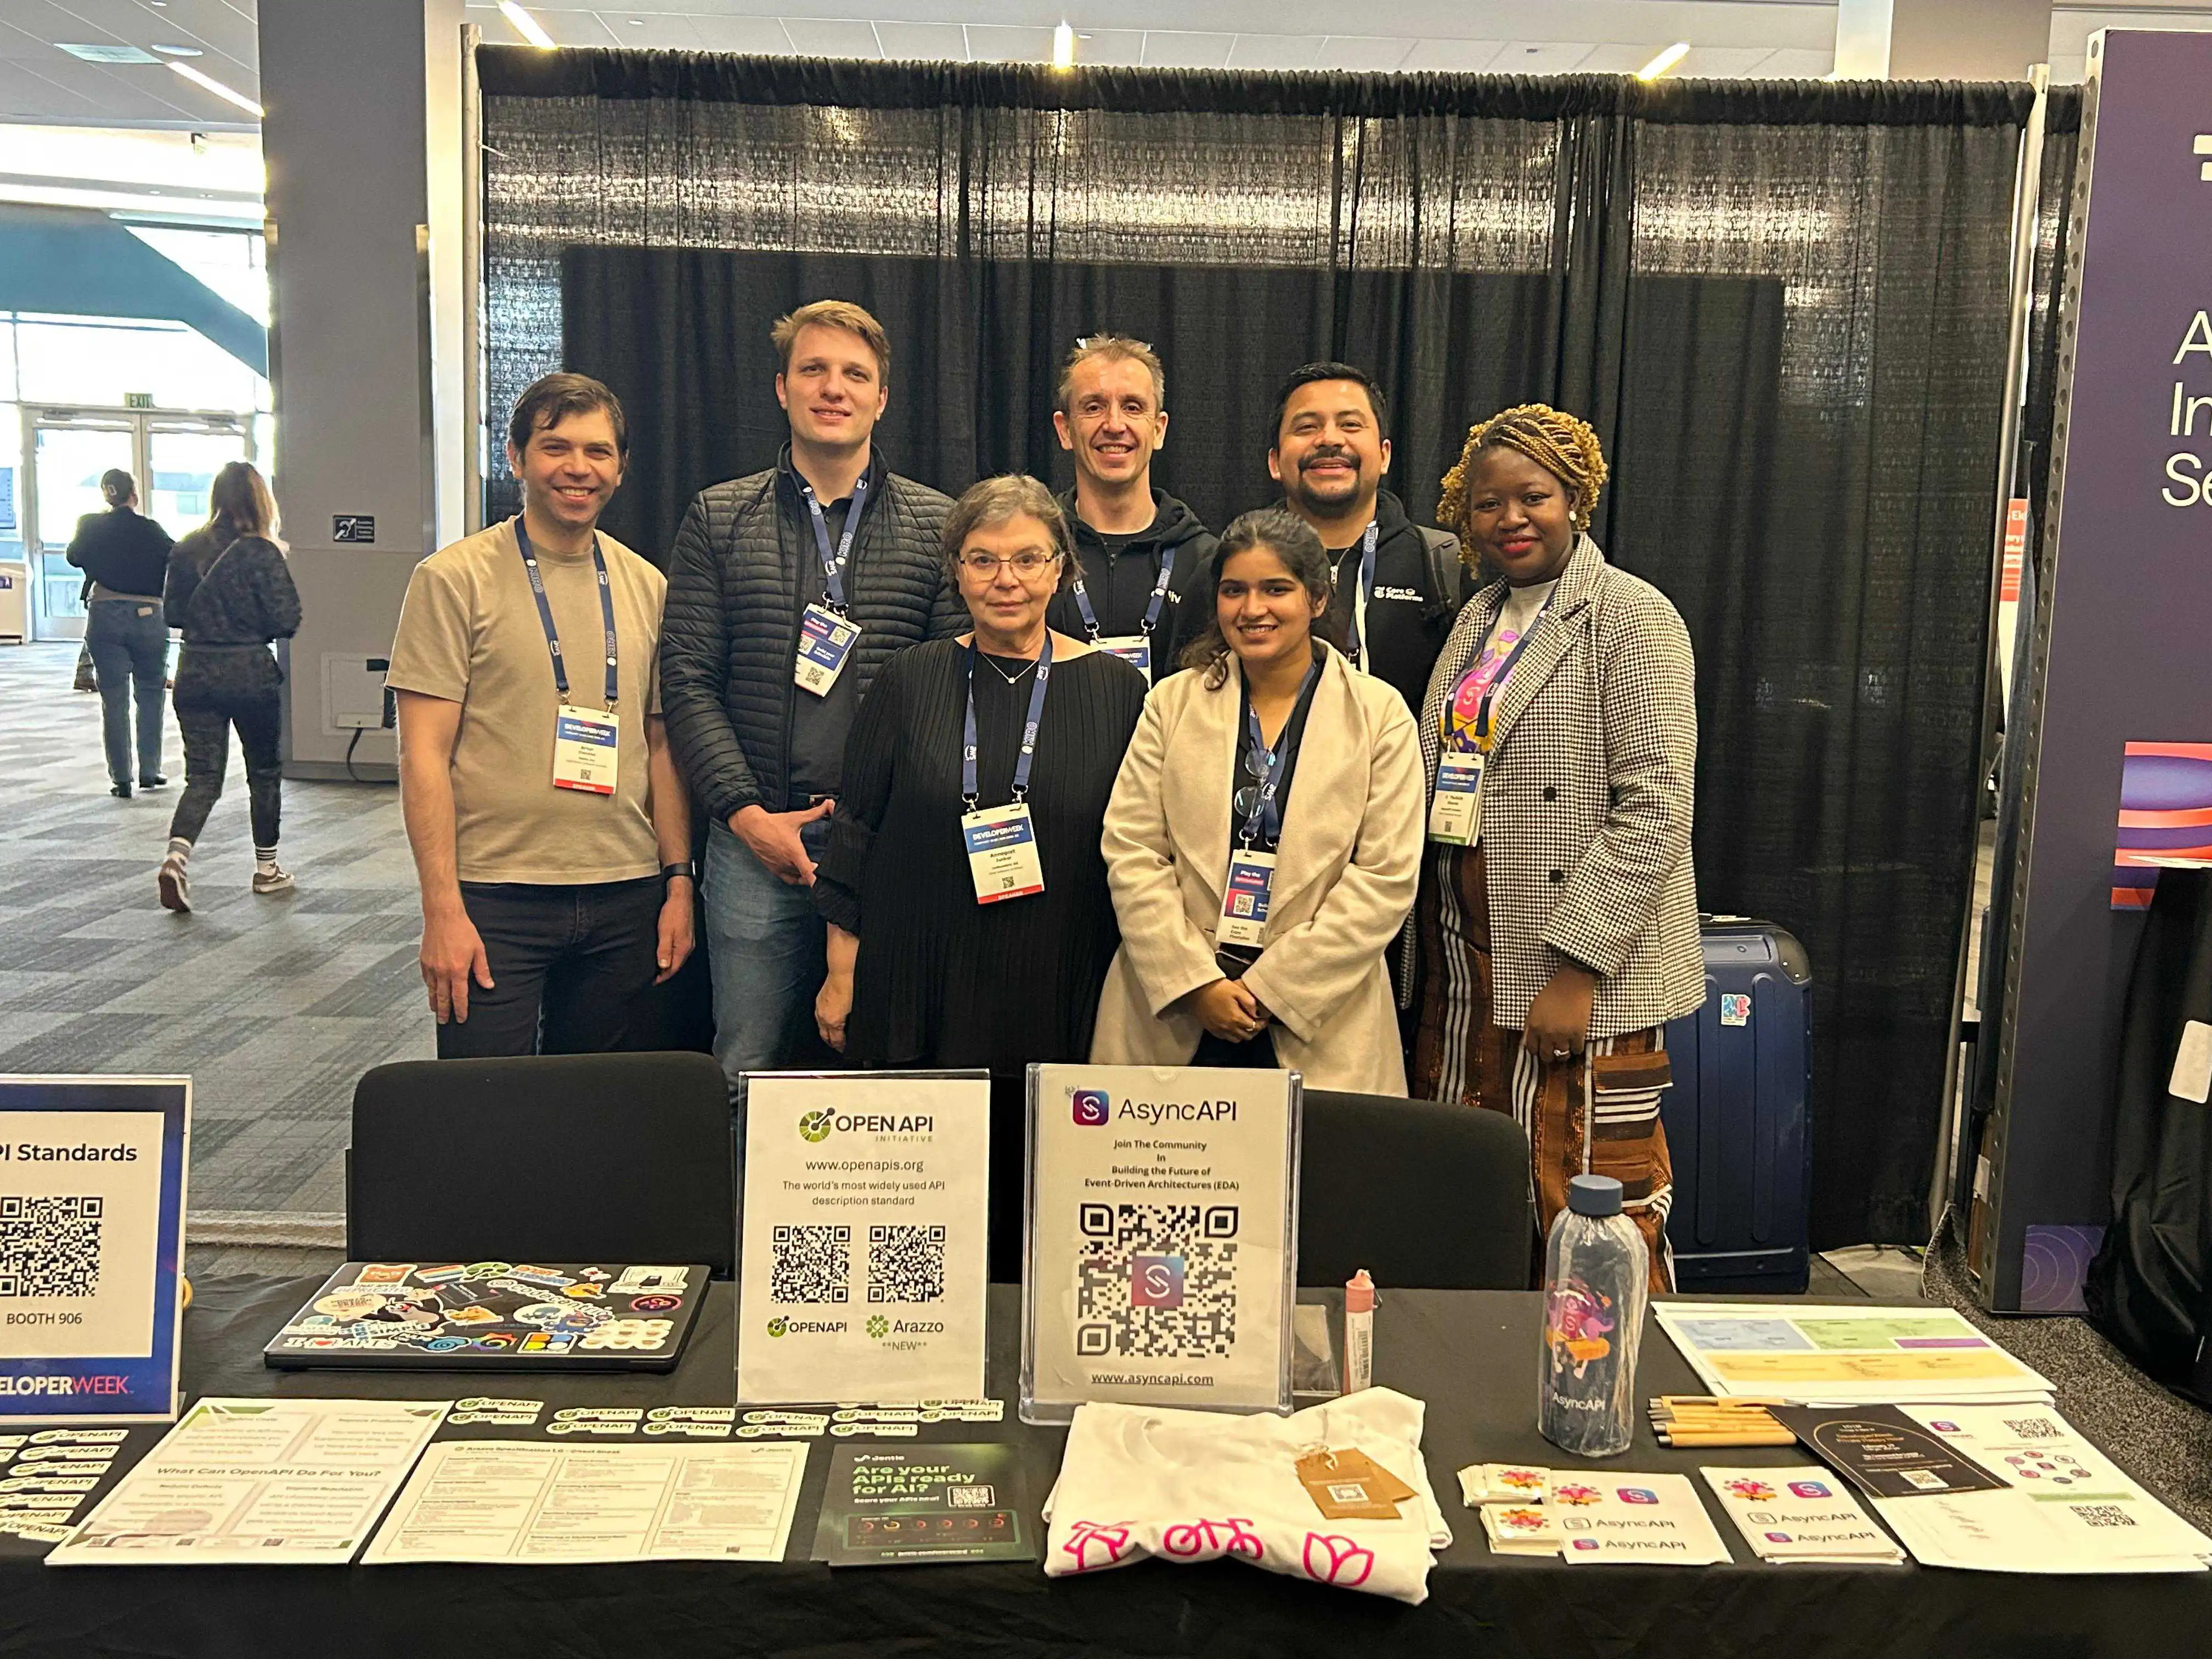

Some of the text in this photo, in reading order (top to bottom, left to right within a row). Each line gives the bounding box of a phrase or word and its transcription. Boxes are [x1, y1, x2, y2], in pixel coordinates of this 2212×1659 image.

[129, 394, 149, 408] EXIT
[837, 532, 853, 557] KIRO
[528, 567, 544, 593] KIRO
[606, 630, 616, 657] KIRO
[1024, 721, 1038, 746] KIRO
[972, 824, 1024, 840] DEVELOPERWEEK
[1118, 1098, 1237, 1125] AsyncAPI
[836, 1115, 933, 1132] OPEN API
[1114, 1139, 1207, 1151] Join The Community
[18, 1143, 137, 1161] Standards
[1156, 1154, 1166, 1162] In
[805, 1159, 924, 1172] www.openapis.org
[1111, 1166, 1212, 1176] Building the Future of
[783, 1180, 945, 1192] The world's most widely used API
[1085, 1178, 1239, 1191] Event-Driven Architectures (EDA)
[812, 1196, 915, 1207] description standard
[7, 1313, 83, 1325] BOOTH 906
[789, 1321, 847, 1333] OPENAPI
[893, 1319, 944, 1333] Arazzo
[1091, 1373, 1214, 1386] www.asyncapi.com
[482, 1400, 538, 1409] OPENAPI
[1552, 1392, 1606, 1412] AsyncAPI
[769, 1414, 826, 1423] OPENAPI
[669, 1423, 727, 1432] OPENAPI
[229, 1468, 295, 1476] OpenAPI
[853, 1464, 951, 1476] Are your
[853, 1472, 975, 1485] APIs ready
[852, 1483, 929, 1494] for AI?
[1596, 1519, 1675, 1529] AsyncAPI
[1781, 1513, 1858, 1523] AsyncAPI
[8, 1520, 69, 1534] OPENAPI
[1797, 1531, 1877, 1543] AsyncAPI
[1605, 1539, 1686, 1550] AsyncAPI
